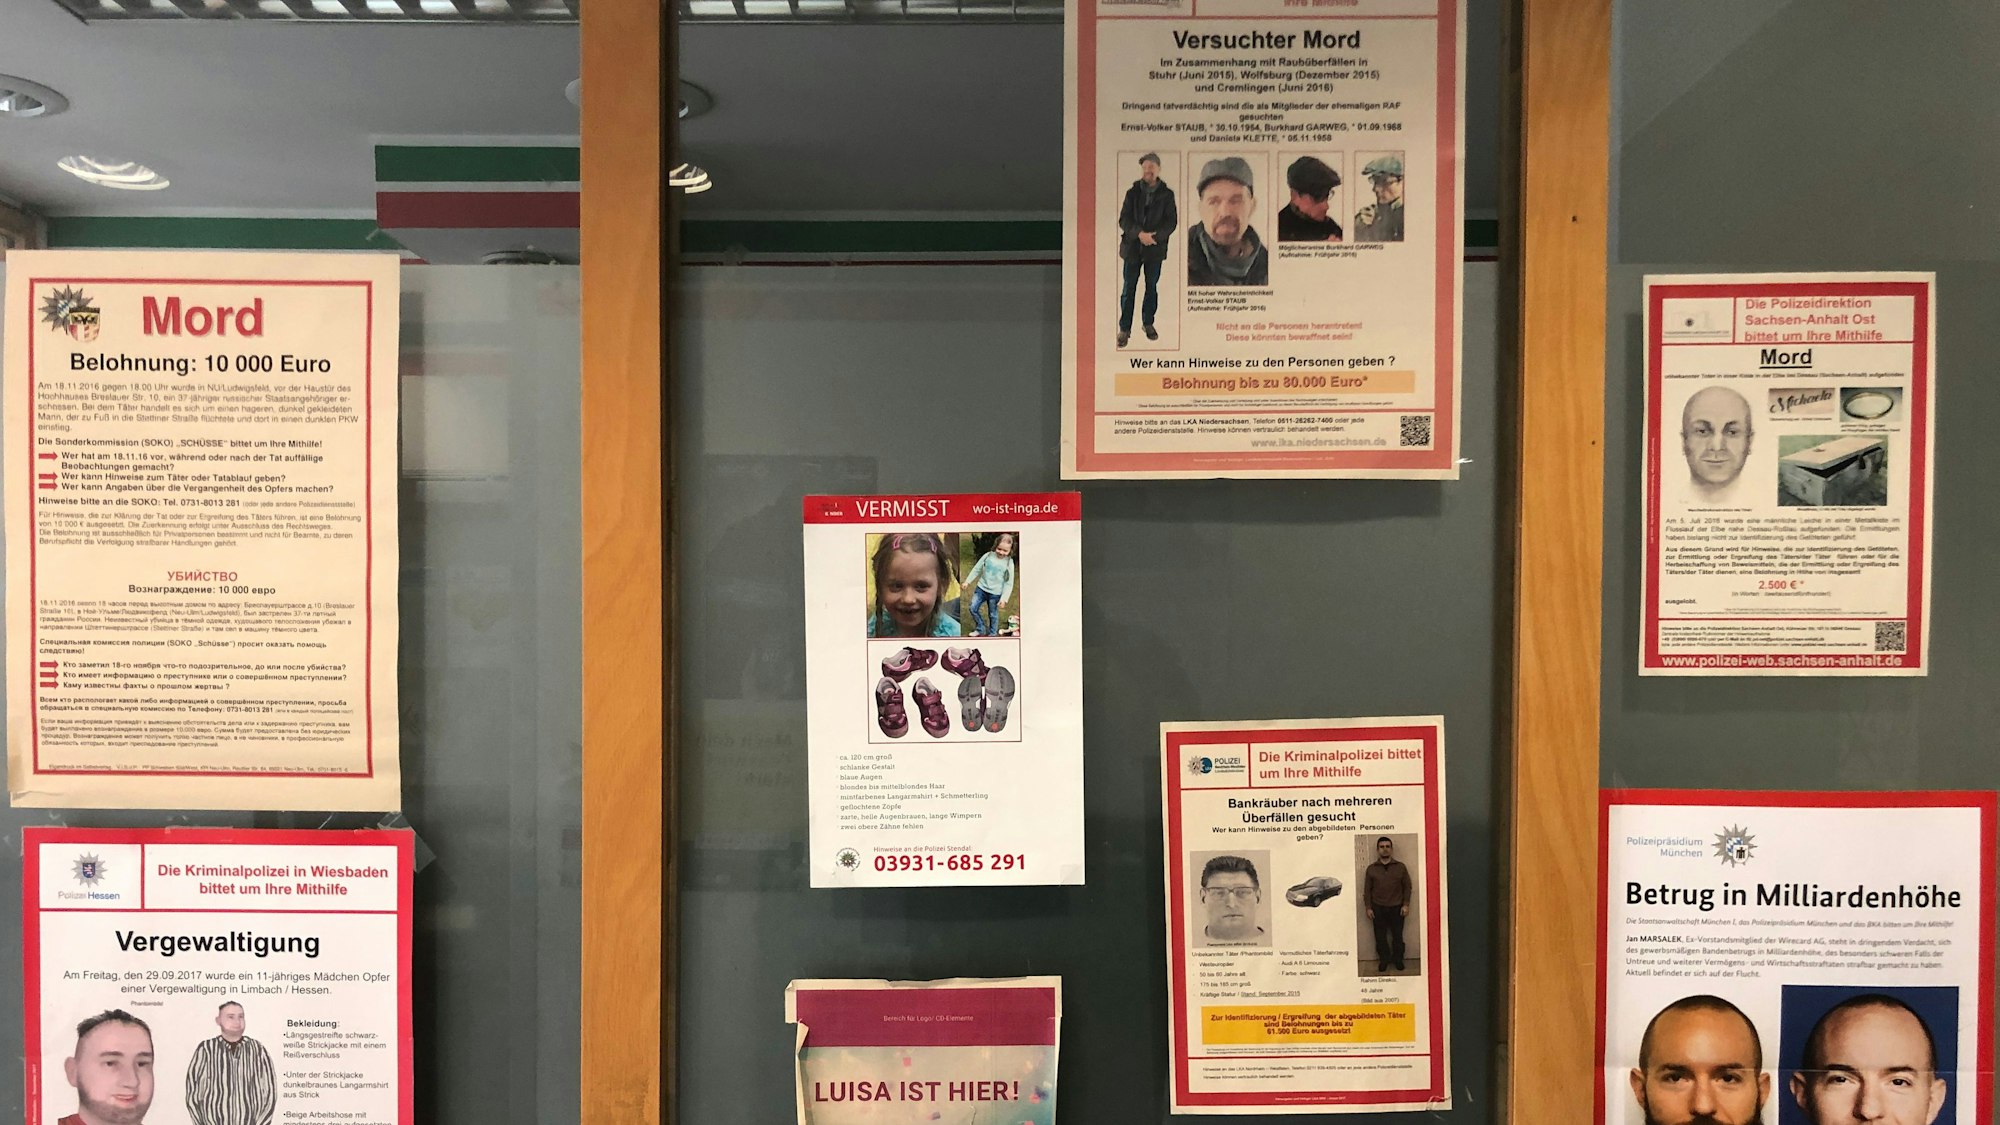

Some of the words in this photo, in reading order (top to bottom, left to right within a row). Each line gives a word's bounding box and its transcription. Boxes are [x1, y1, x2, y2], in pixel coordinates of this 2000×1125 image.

[1172, 29, 1296, 49] Versuchter
[1303, 29, 1360, 49] Mord
[1160, 57, 1173, 67] Im
[1175, 57, 1257, 68] Zusammenhang
[1259, 57, 1276, 66] mit
[1278, 57, 1356, 66] Raubüberfällen
[1358, 57, 1368, 66] in
[1148, 70, 1176, 80] Stuhr
[1179, 70, 1204, 80] (Juni
[1240, 70, 1292, 81] Wolfsburg
[1294, 69, 1350, 81] (Dezember
[1352, 70, 1379, 80] 2015)
[1194, 83, 1214, 92] und
[1217, 82, 1275, 94] Cremlingen
[1278, 82, 1304, 93] (Juni
[1306, 82, 1333, 93] 2016)
[1745, 298, 1767, 309] Die
[1770, 296, 1872, 308] Polizeidirektion
[142, 296, 263, 337] Mord
[1744, 313, 1849, 325] Sachsen-Anhalt
[1852, 313, 1875, 324] Ost
[1744, 330, 1780, 341] bittet
[1782, 332, 1804, 341] um
[1807, 330, 1832, 341] Ihre
[1835, 330, 1883, 341] Mithilfe
[1129, 358, 1153, 368] Wer
[1156, 358, 1184, 368] kann
[1188, 357, 1241, 368] Hinweise
[1245, 359, 1258, 367] zu
[1262, 357, 1284, 367] den
[1288, 356, 1344, 367] Personen
[1348, 356, 1384, 368] geben
[1760, 348, 1812, 366] Mord
[70, 352, 196, 376] Belohnung:
[204, 354, 228, 372] 10
[235, 354, 272, 372] 000
[280, 354, 330, 372] Euro
[1162, 376, 1235, 392] Belohnung
[1239, 376, 1259, 388] bis
[1262, 379, 1279, 388] zu
[1282, 375, 1326, 388] 80.000
[37, 437, 52, 445] Die
[140, 438, 173, 447] (SOKO)
[230, 439, 251, 447] bittet
[1250, 436, 1387, 447] www.lka.niedersachsen.de
[38, 496, 78, 505] Hinweise
[80, 497, 100, 505] bitte
[180, 498, 223, 506] 0731-8013
[855, 499, 950, 518] VERMISST
[972, 501, 1058, 516] wo-ist-inga.de
[167, 569, 238, 582] УБИЙСТВО
[128, 584, 215, 595] Вознаграждение:
[218, 585, 229, 593] 10
[231, 585, 249, 594] 000
[251, 587, 276, 596] евро
[1758, 580, 1787, 589] 2.500
[1662, 655, 1902, 668] www.polizei-web.sachsen-anhalt.de
[875, 753, 892, 761] groß
[1215, 758, 1241, 766] POLIZEI
[1259, 751, 1280, 762] Die
[1284, 748, 1383, 764] Kriminalpolizei
[1387, 748, 1421, 759] bittet
[1259, 770, 1279, 778] um
[1284, 767, 1309, 778] Ihre
[1313, 765, 1362, 777] Mithilfe
[1228, 797, 1298, 808] Bankräuber
[1301, 796, 1330, 807] nach
[1334, 795, 1392, 806] mehreren
[949, 812, 982, 820] Wimpern
[1242, 810, 1303, 822] Überfällen
[1307, 811, 1356, 824] gesucht
[1626, 836, 1703, 847] Polizeipräsidium
[1660, 847, 1702, 857] München
[990, 853, 1024, 870] 291
[157, 864, 181, 876] Die
[185, 864, 289, 879] Kriminalpolizei
[293, 865, 306, 877] in
[310, 865, 388, 878] Wiesbaden
[199, 882, 235, 894] bittet
[239, 885, 260, 894] um
[265, 882, 292, 894] Ihre
[296, 883, 347, 895] Mithilfe
[87, 891, 120, 900] Hessen
[1626, 881, 1715, 911] Betrug
[1723, 882, 1746, 905] in
[1756, 882, 1960, 908] Milliardenhöhe
[115, 930, 319, 958] Vergewaltigung
[63, 970, 80, 979] Am
[83, 970, 121, 981] Freitag,
[123, 971, 143, 980] den
[145, 970, 202, 980] 29.09.2017
[205, 971, 235, 980] wurde
[257, 971, 311, 983] 11-jähriges
[313, 971, 359, 981] Mädchen
[362, 972, 390, 983] Opfer
[1625, 968, 1651, 976] Aktuell
[1652, 968, 1682, 976] befindet
[1708, 969, 1720, 977] auf
[120, 985, 146, 993] einer
[148, 984, 226, 995] Vergewaltigung
[240, 984, 282, 994] Limbach
[291, 985, 331, 994] Hessen.
[307, 1041, 348, 1050] Strickjacke
[283, 1050, 340, 1058] Reißverschluss
[815, 1081, 891, 1101] LUISA
[900, 1081, 941, 1101] IST
[949, 1081, 1018, 1101] HIER!
